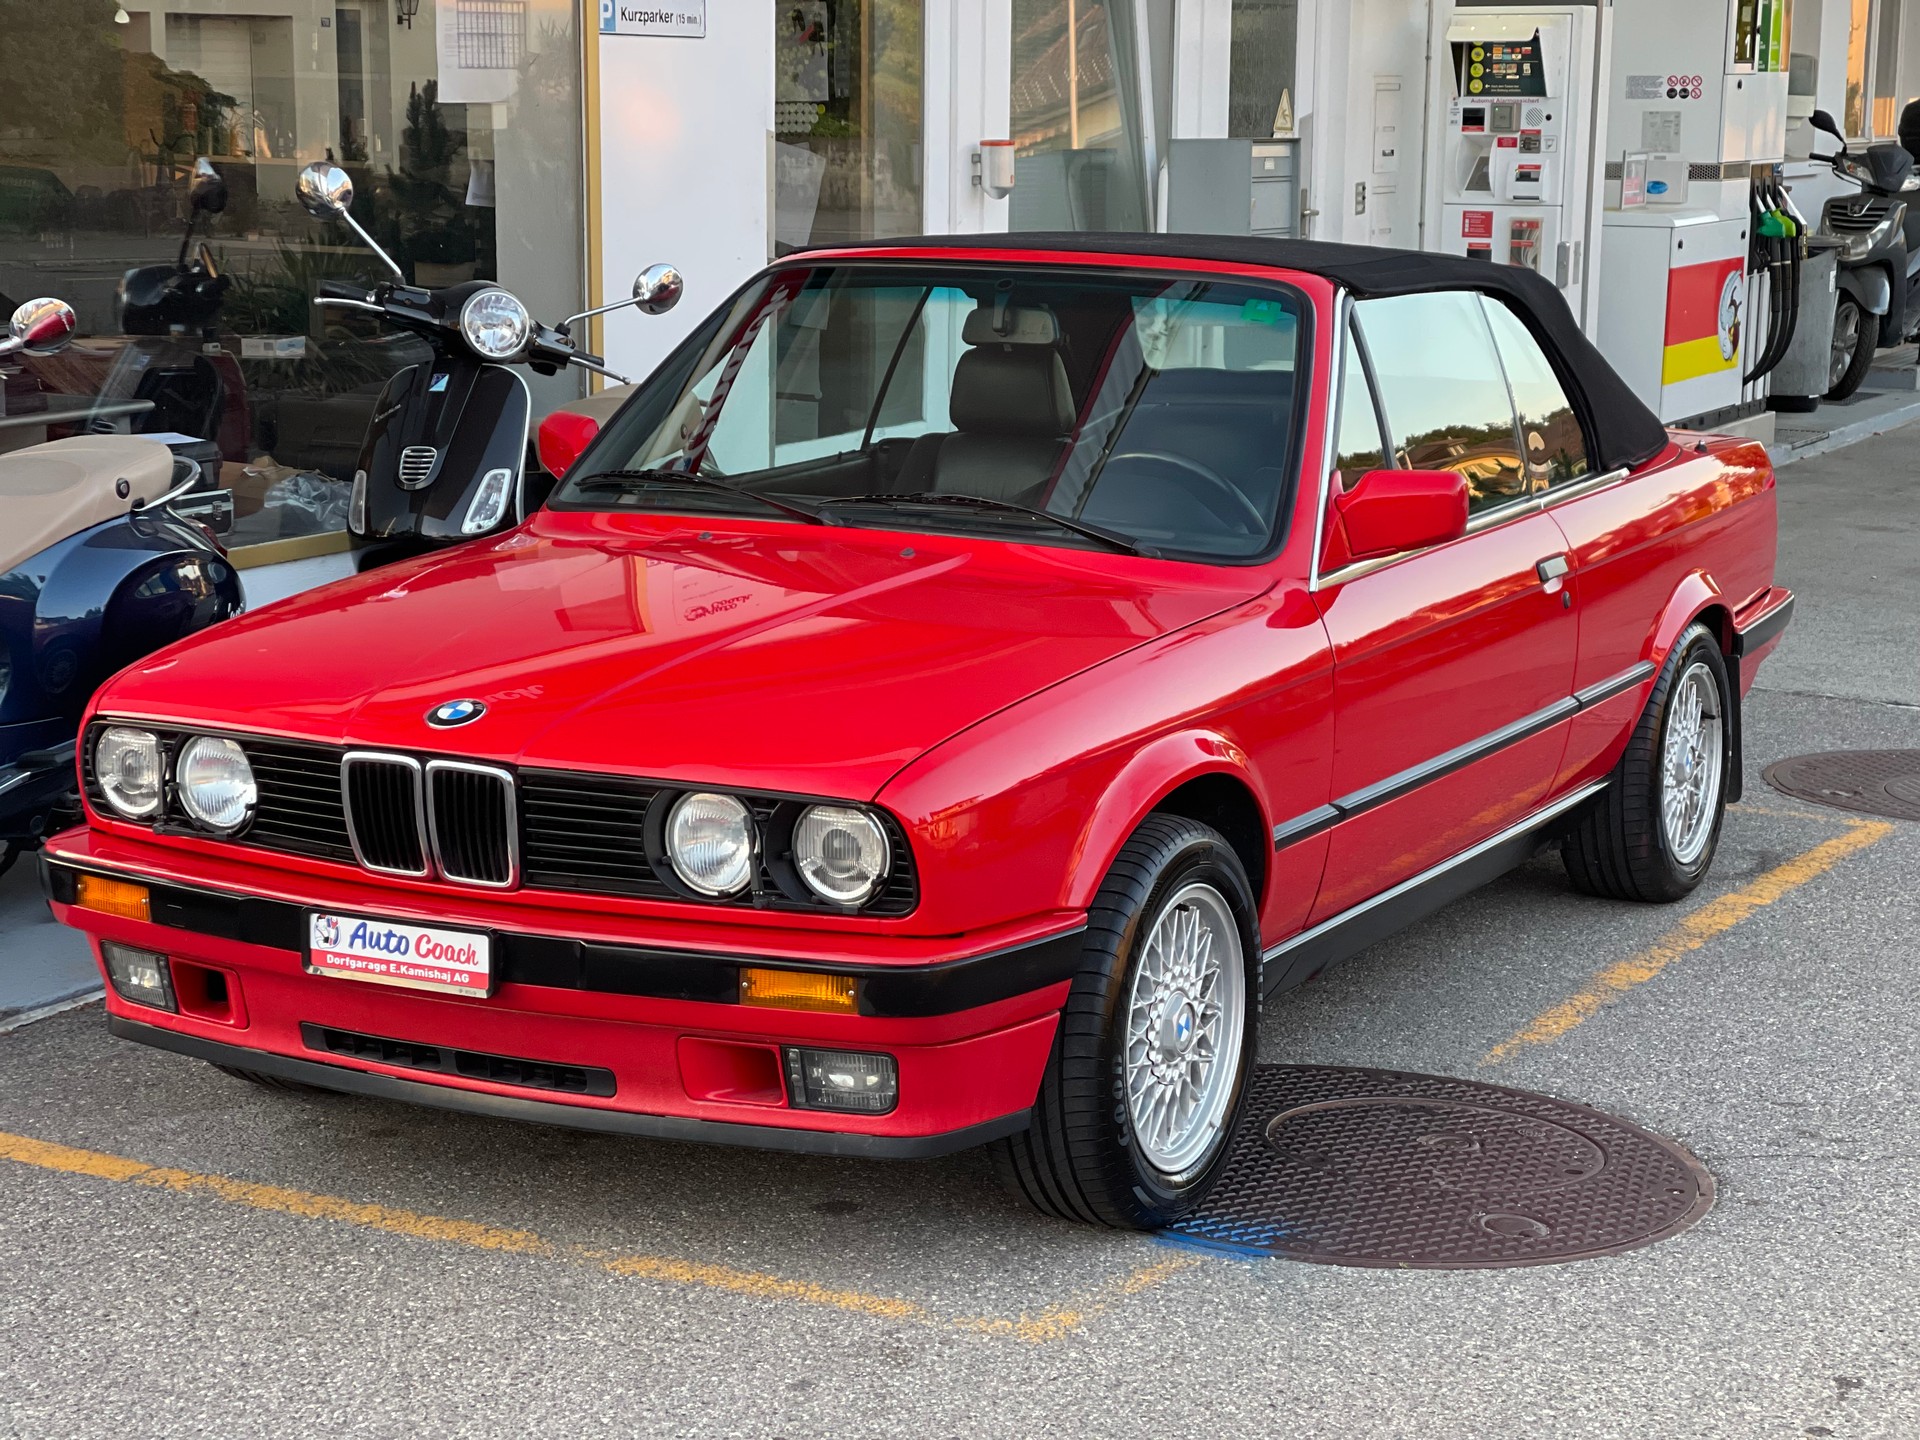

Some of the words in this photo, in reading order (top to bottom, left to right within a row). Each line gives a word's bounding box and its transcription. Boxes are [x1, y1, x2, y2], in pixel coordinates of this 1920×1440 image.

[599, 0, 613, 29] P
[620, 6, 674, 26] Kurzparker
[675, 13, 686, 26] (15
[687, 13, 702, 28] min.)
[348, 921, 410, 956] Auto
[414, 933, 479, 966] Coach
[326, 953, 387, 972] Dorfgarage
[389, 961, 451, 983] E.Kamishaj
[453, 972, 470, 983] AG
